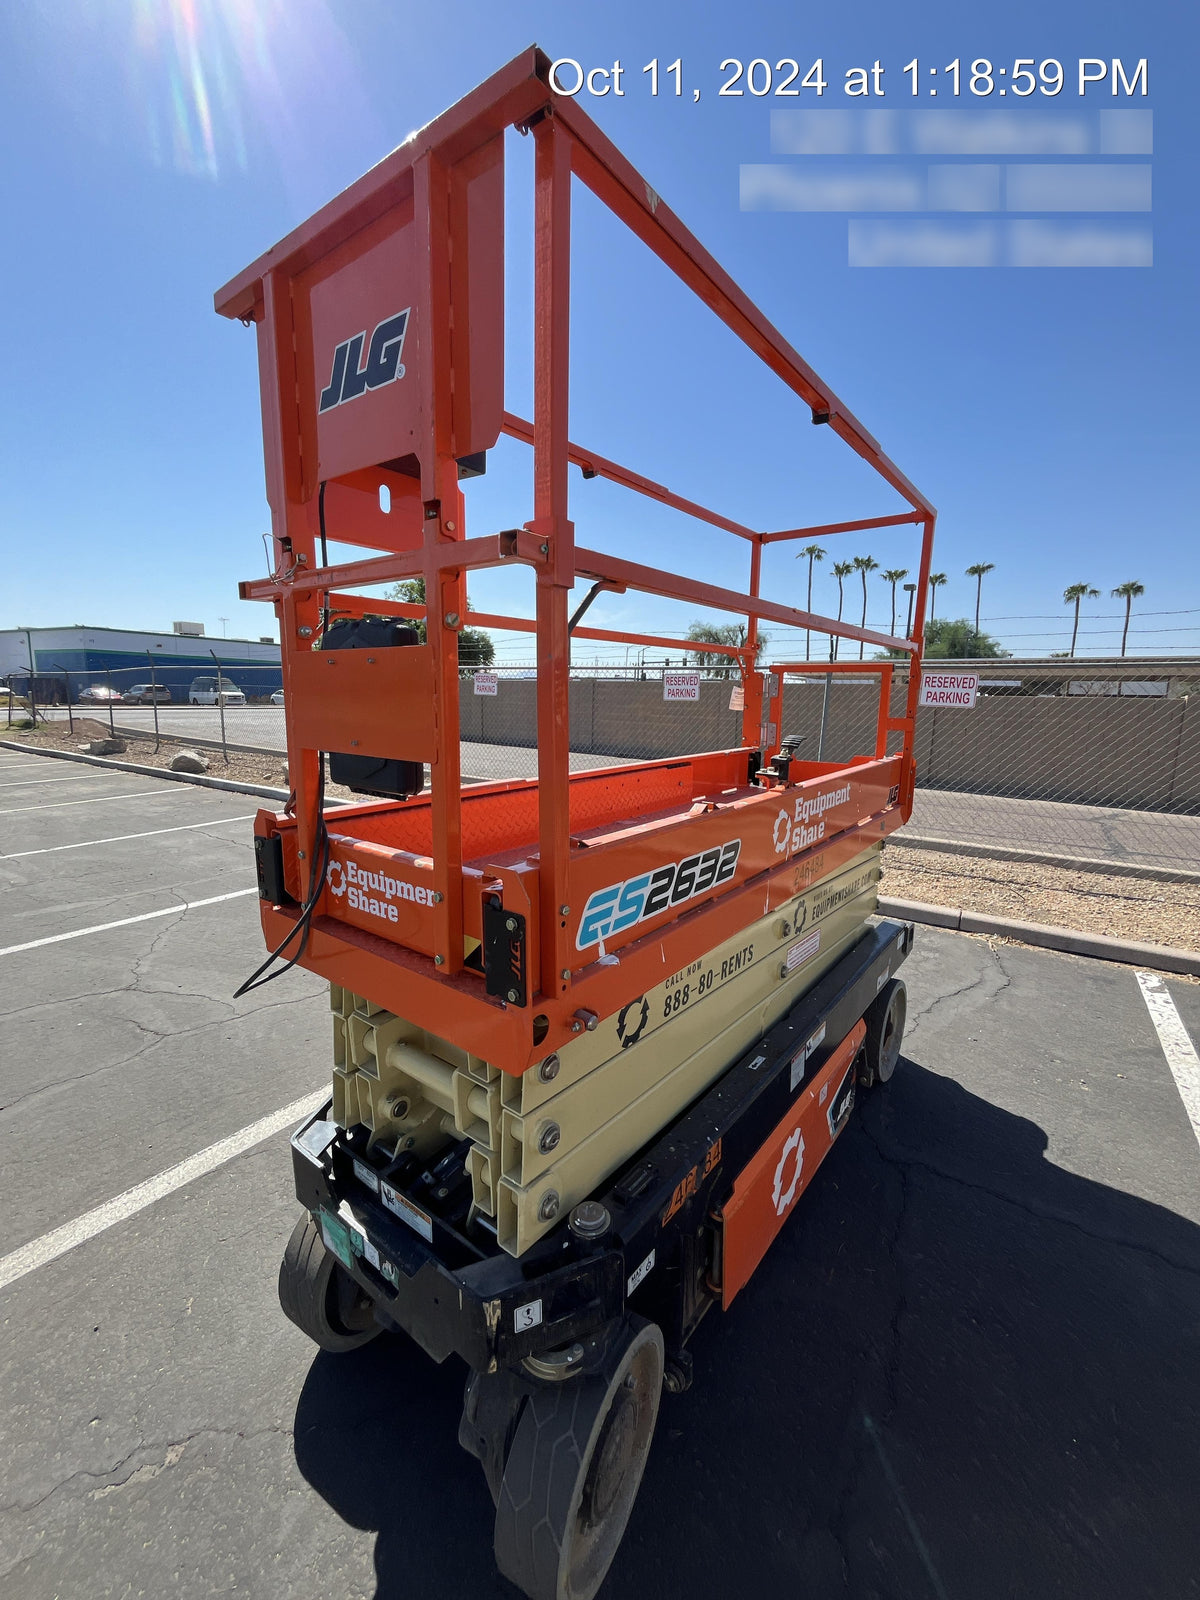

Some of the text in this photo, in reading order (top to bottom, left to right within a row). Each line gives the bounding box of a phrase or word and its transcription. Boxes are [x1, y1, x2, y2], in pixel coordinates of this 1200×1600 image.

[319, 307, 411, 415] JLG
[665, 676, 698, 686] RESERVED
[667, 688, 696, 698] PARKING
[924, 676, 975, 690] RESERVED
[925, 691, 971, 704] PARKING
[794, 782, 852, 822] Equipment
[792, 821, 825, 851] Share
[347, 887, 399, 922] Share
[577, 839, 741, 950] ES2632
[664, 944, 754, 1017] 888-80-RENTS
[665, 959, 703, 989] CALL NOW
